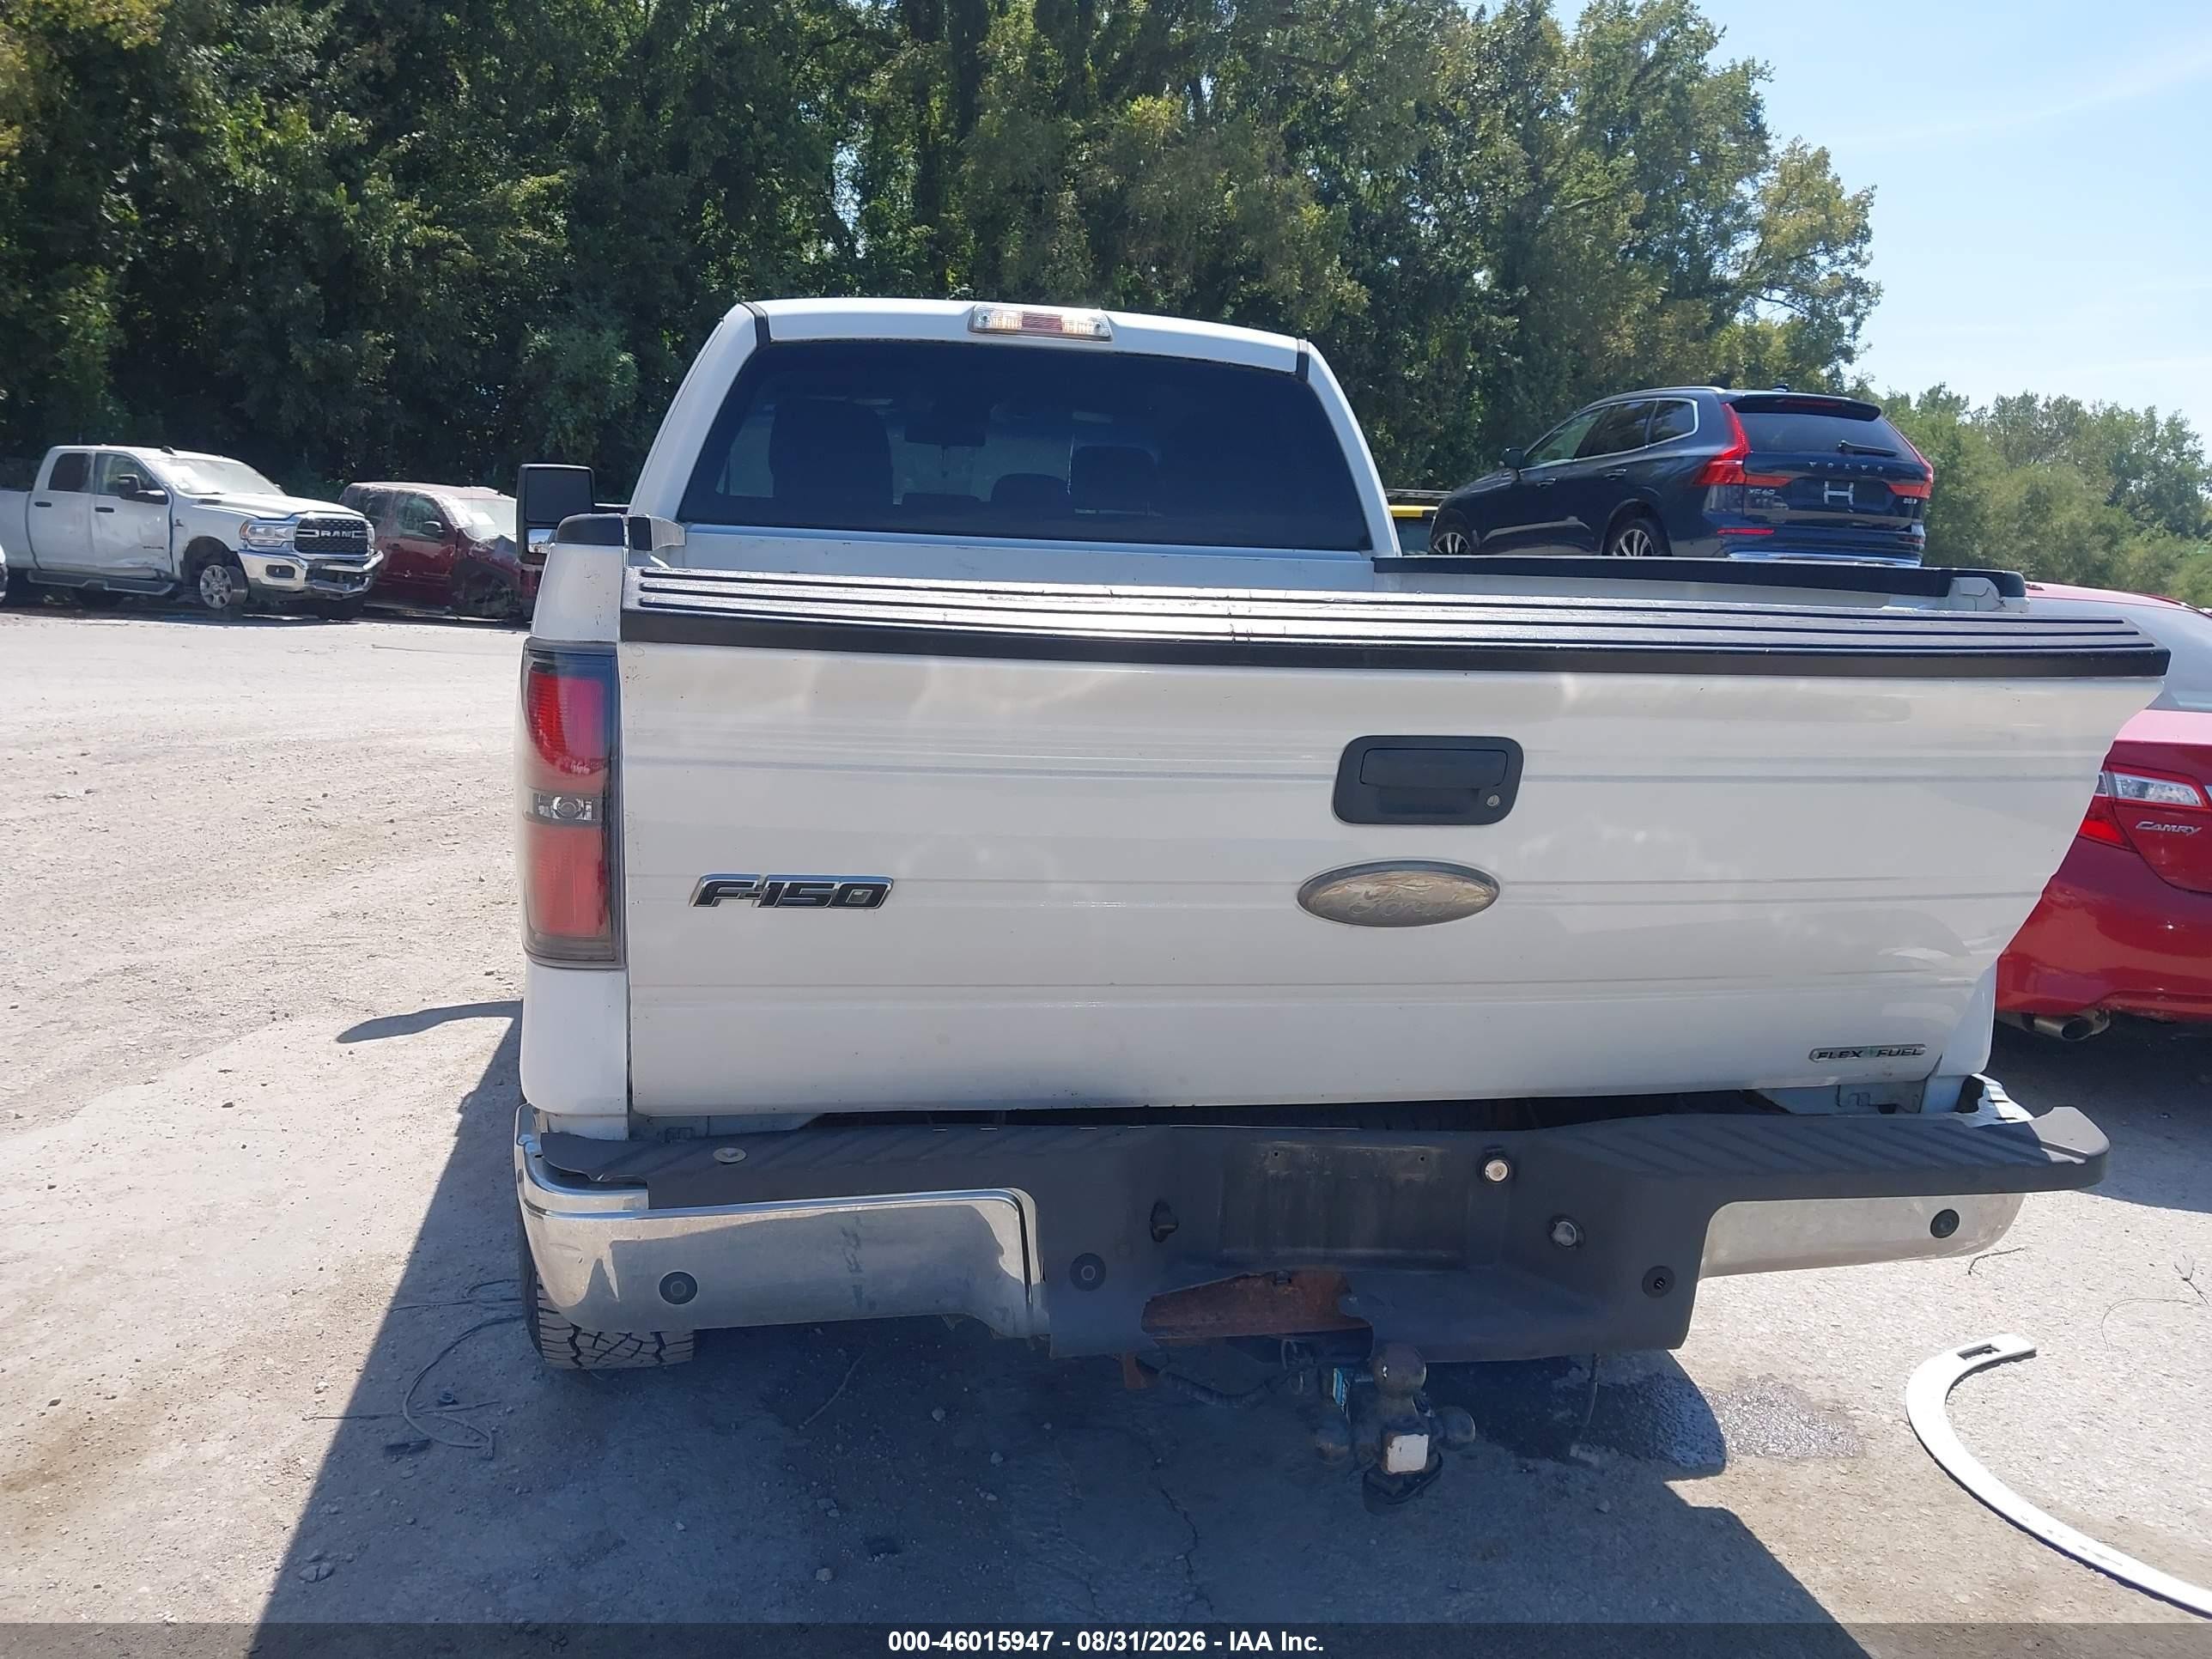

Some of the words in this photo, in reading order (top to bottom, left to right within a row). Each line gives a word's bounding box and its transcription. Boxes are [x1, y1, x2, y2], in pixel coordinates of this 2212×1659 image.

[1808, 461, 1883, 472] VOLVO
[2136, 821, 2203, 836] CAMRY
[690, 874, 894, 909] F-150
[1816, 1050, 1864, 1060] FLEX
[1876, 1048, 1924, 1058] FUEL
